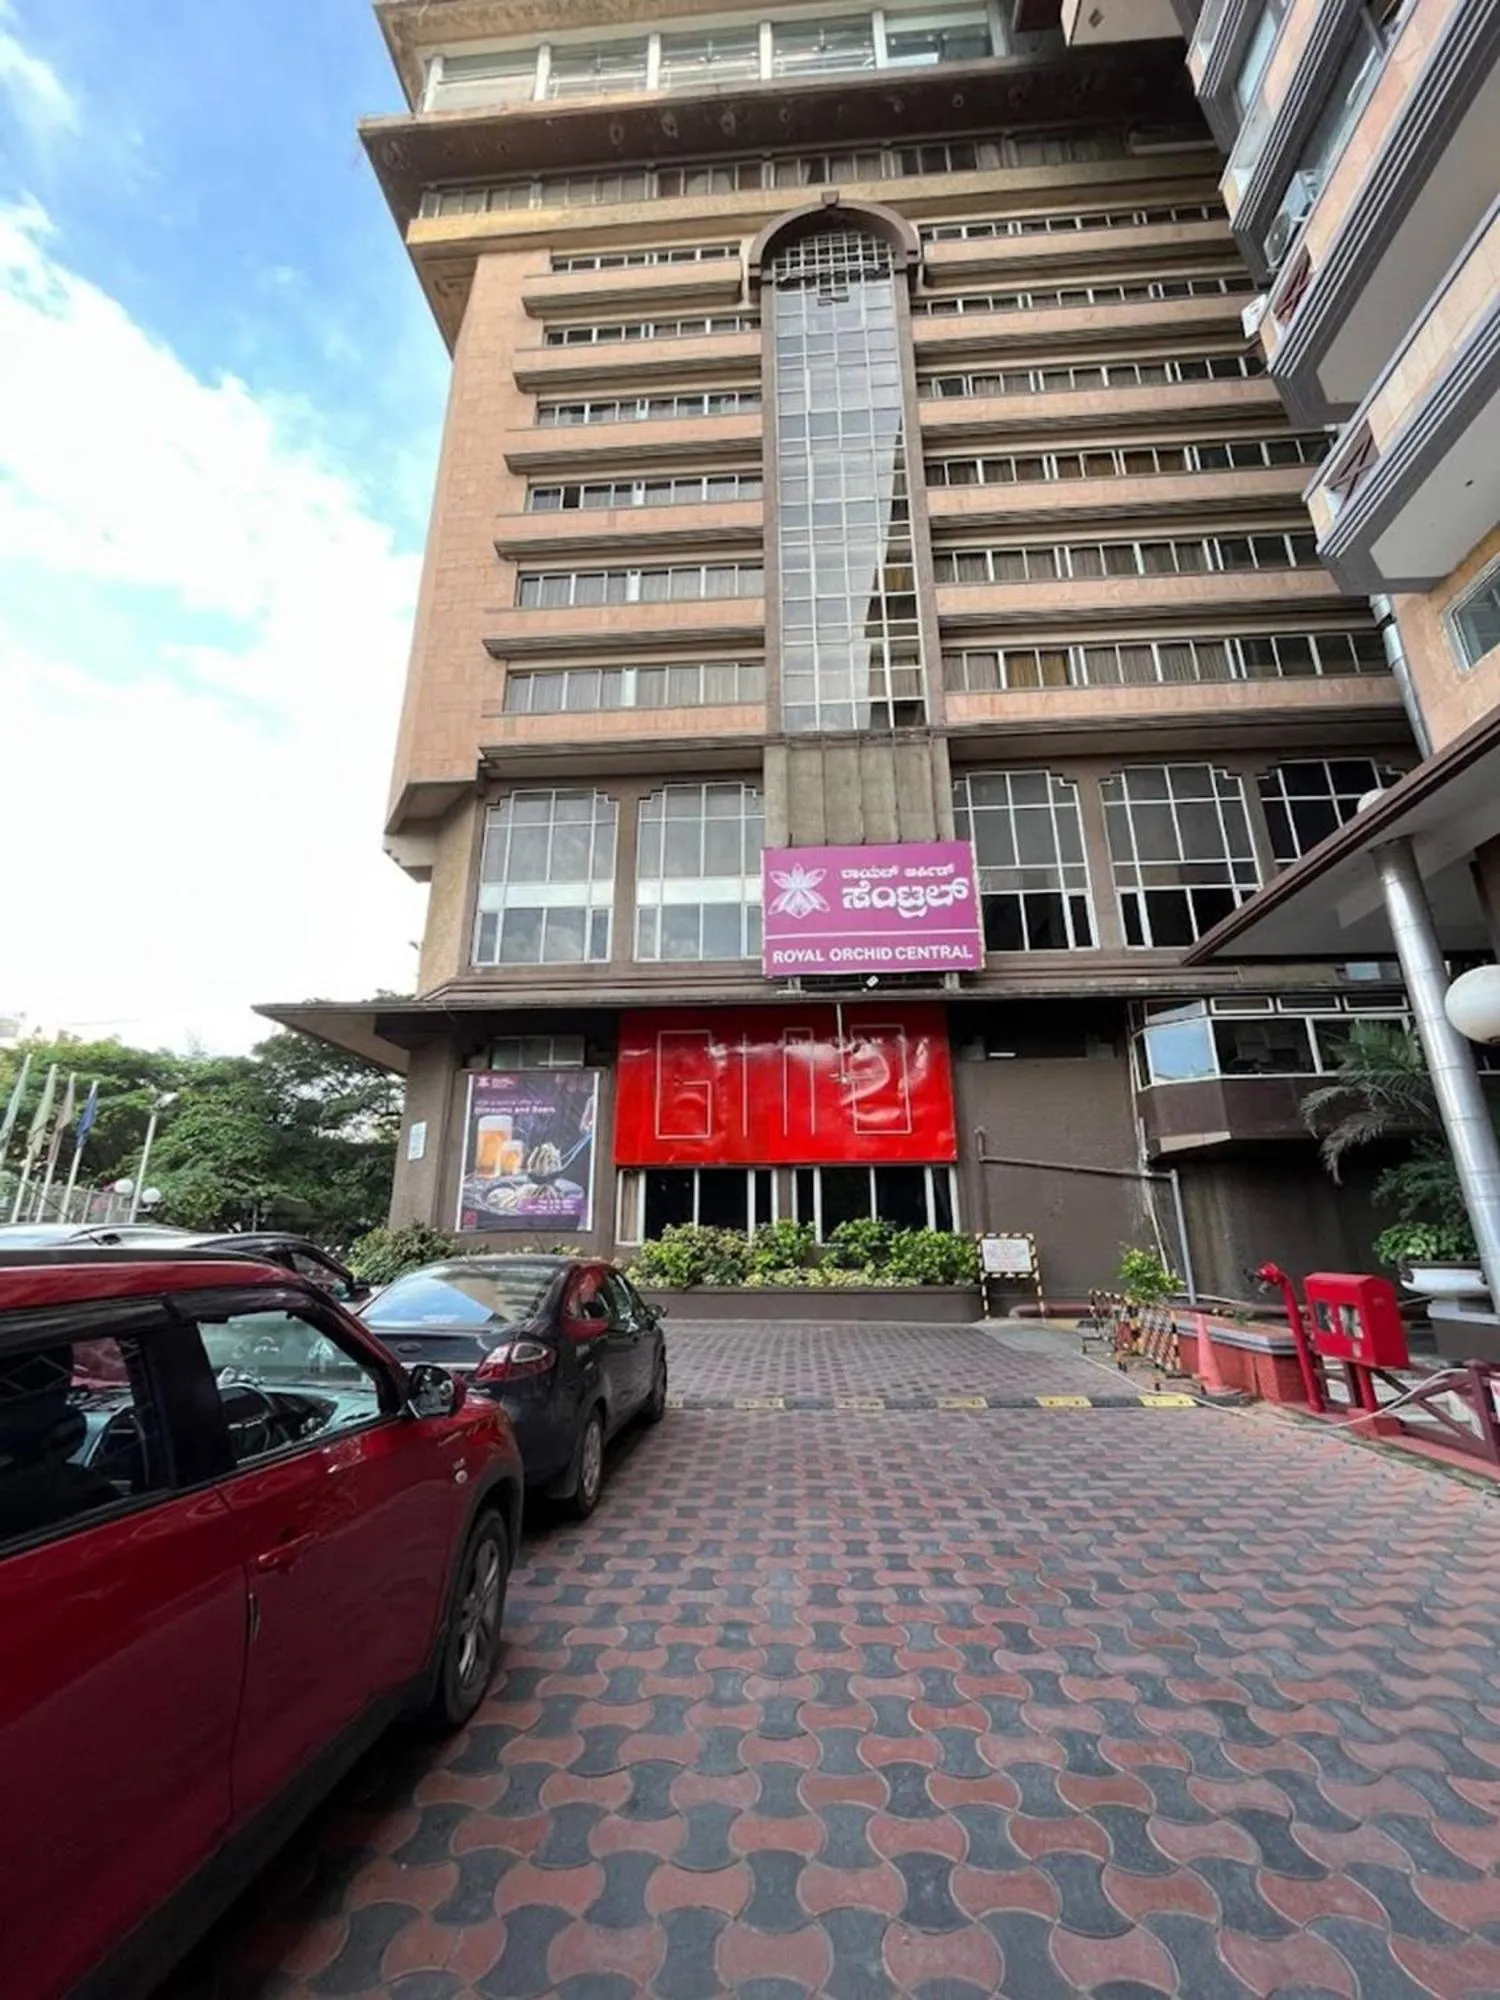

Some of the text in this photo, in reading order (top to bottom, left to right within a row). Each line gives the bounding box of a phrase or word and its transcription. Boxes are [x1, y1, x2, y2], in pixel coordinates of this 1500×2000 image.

[841, 877, 970, 919] ಸೆಂಟ್ರಲ್
[772, 944, 974, 965] ROYAL ORCHID CENTRAL
